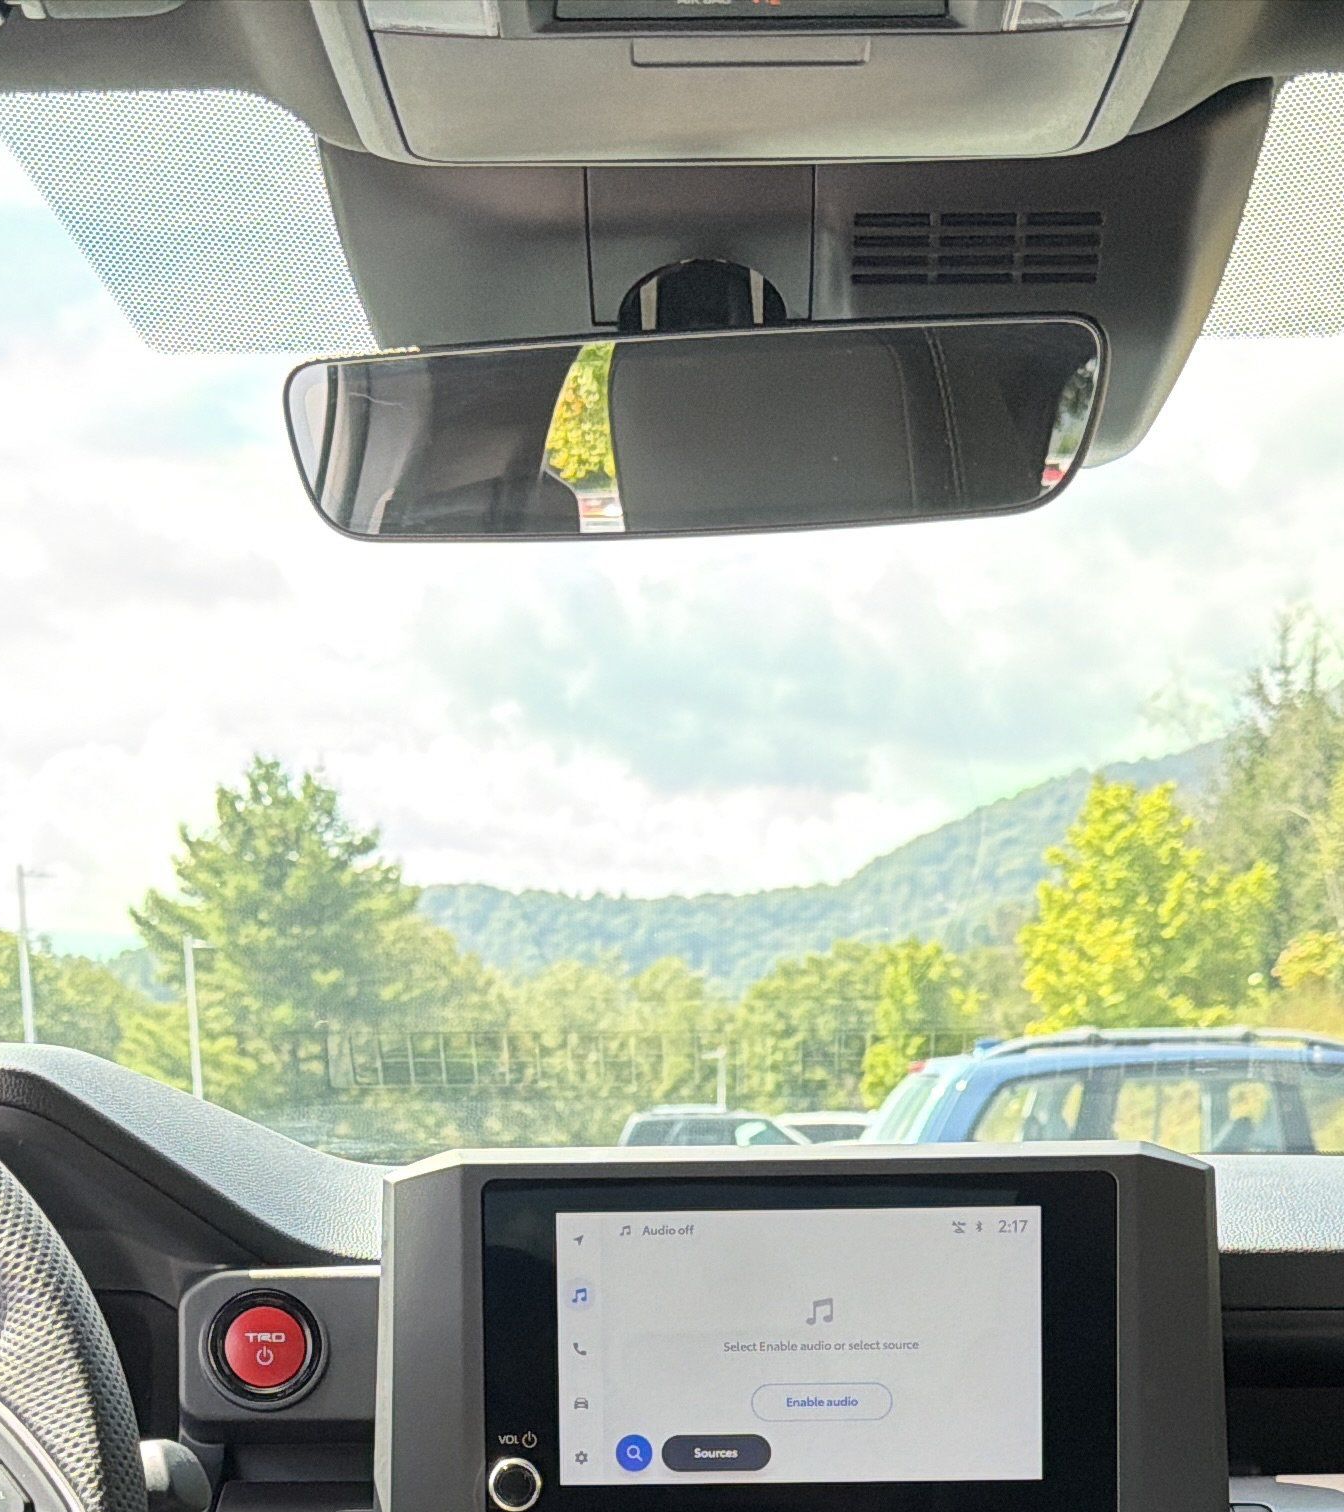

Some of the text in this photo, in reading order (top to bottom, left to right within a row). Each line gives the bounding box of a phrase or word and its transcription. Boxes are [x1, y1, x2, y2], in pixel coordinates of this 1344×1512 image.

[642, 1224, 694, 1236] Audio off
[998, 1220, 1027, 1233] 2:17
[244, 1332, 286, 1343] TRD
[723, 1340, 920, 1352] Select Enable audio or select source
[786, 1395, 859, 1408] Enable audio
[498, 1435, 520, 1445] VOL
[693, 1447, 739, 1459] Sources
